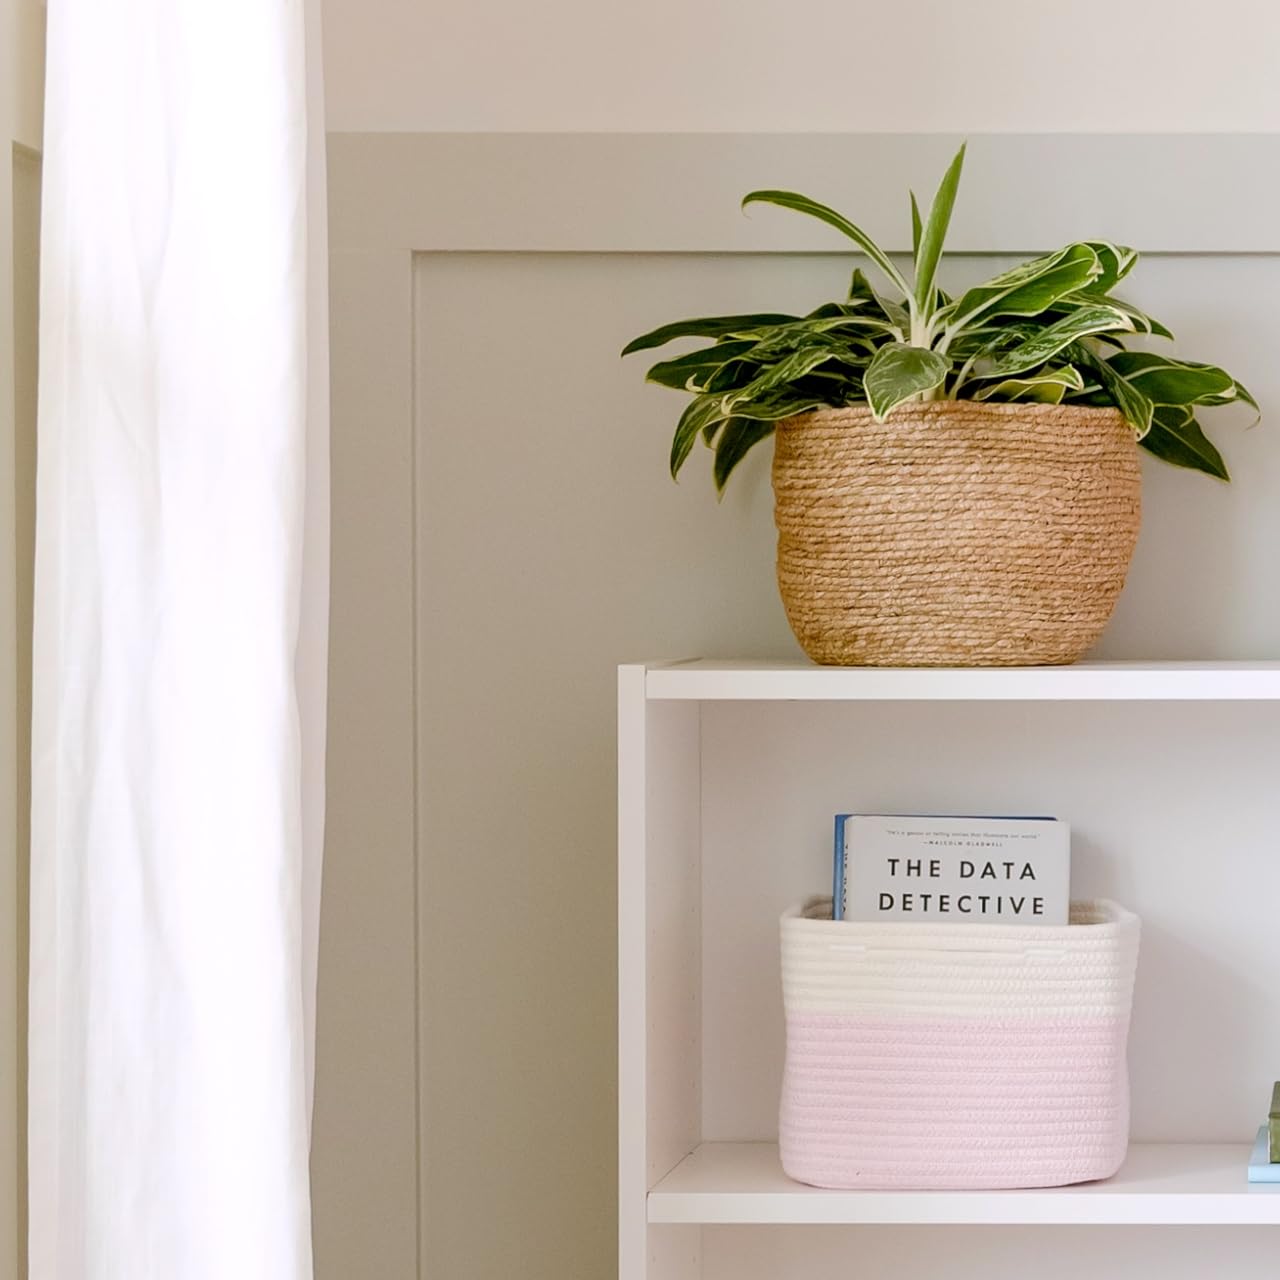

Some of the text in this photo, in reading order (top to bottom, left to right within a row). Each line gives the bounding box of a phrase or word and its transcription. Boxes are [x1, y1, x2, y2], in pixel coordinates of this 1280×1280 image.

[887, 858, 1036, 880] THE DATA
[878, 892, 1044, 915] DETECTIVE
